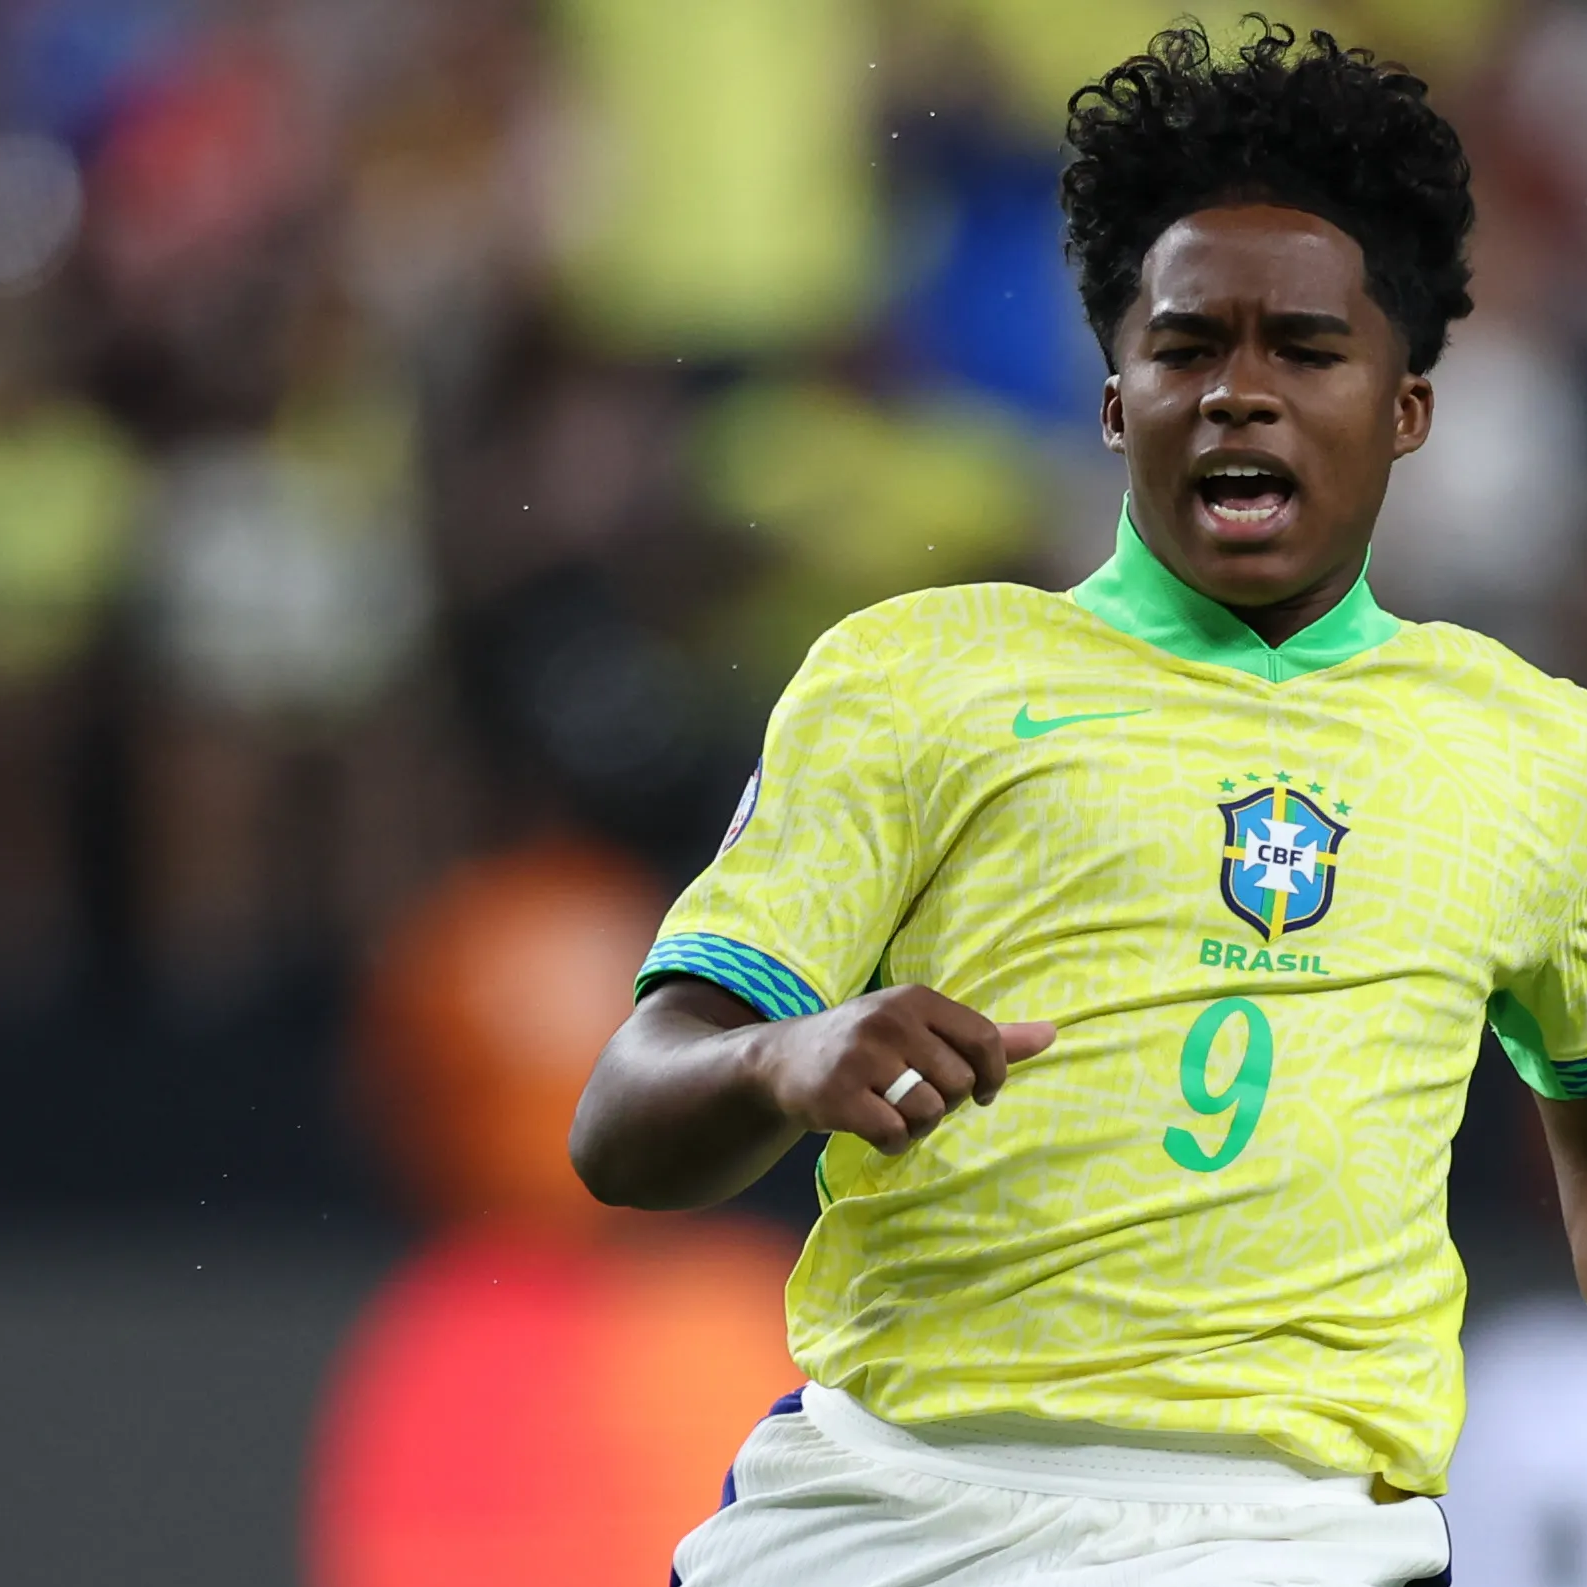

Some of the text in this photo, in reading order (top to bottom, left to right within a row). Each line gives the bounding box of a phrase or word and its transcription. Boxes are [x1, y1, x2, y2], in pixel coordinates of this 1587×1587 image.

[1257, 844, 1303, 866] CBF
[1199, 938, 1330, 975] BRASIL
[1163, 997, 1273, 1172] 9
